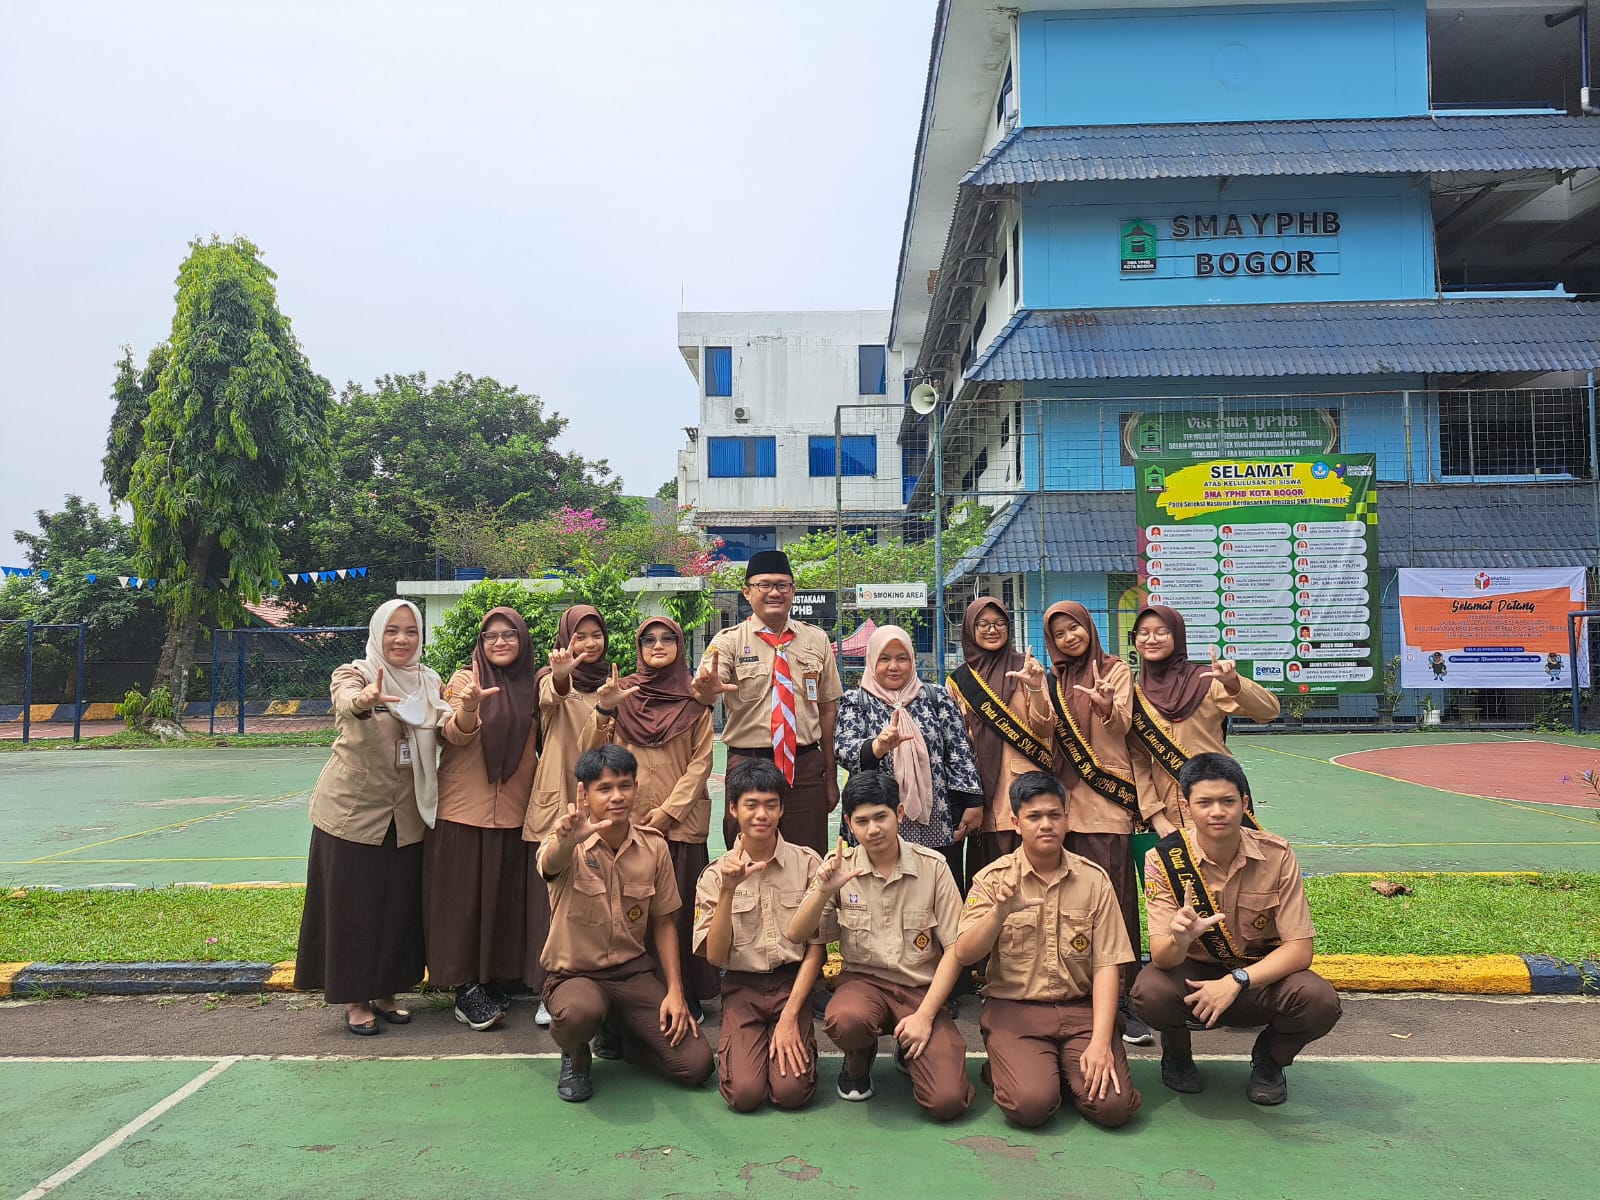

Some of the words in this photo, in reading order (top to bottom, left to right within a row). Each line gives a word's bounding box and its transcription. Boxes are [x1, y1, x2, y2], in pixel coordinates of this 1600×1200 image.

[1196, 250, 1316, 276] BOGOR
[1187, 416, 1212, 428] Visi
[1210, 463, 1295, 479] SELAMAT
[1204, 491, 1222, 499] SMA
[1225, 490, 1247, 498] YPHB
[1249, 489, 1272, 497] KOTA
[873, 591, 905, 599] SMOKING
[906, 591, 924, 599] AREA
[792, 605, 813, 616] PHB
[1452, 599, 1495, 613] Selamat
[1497, 600, 1536, 613] Datang
[1255, 666, 1281, 676] genza
